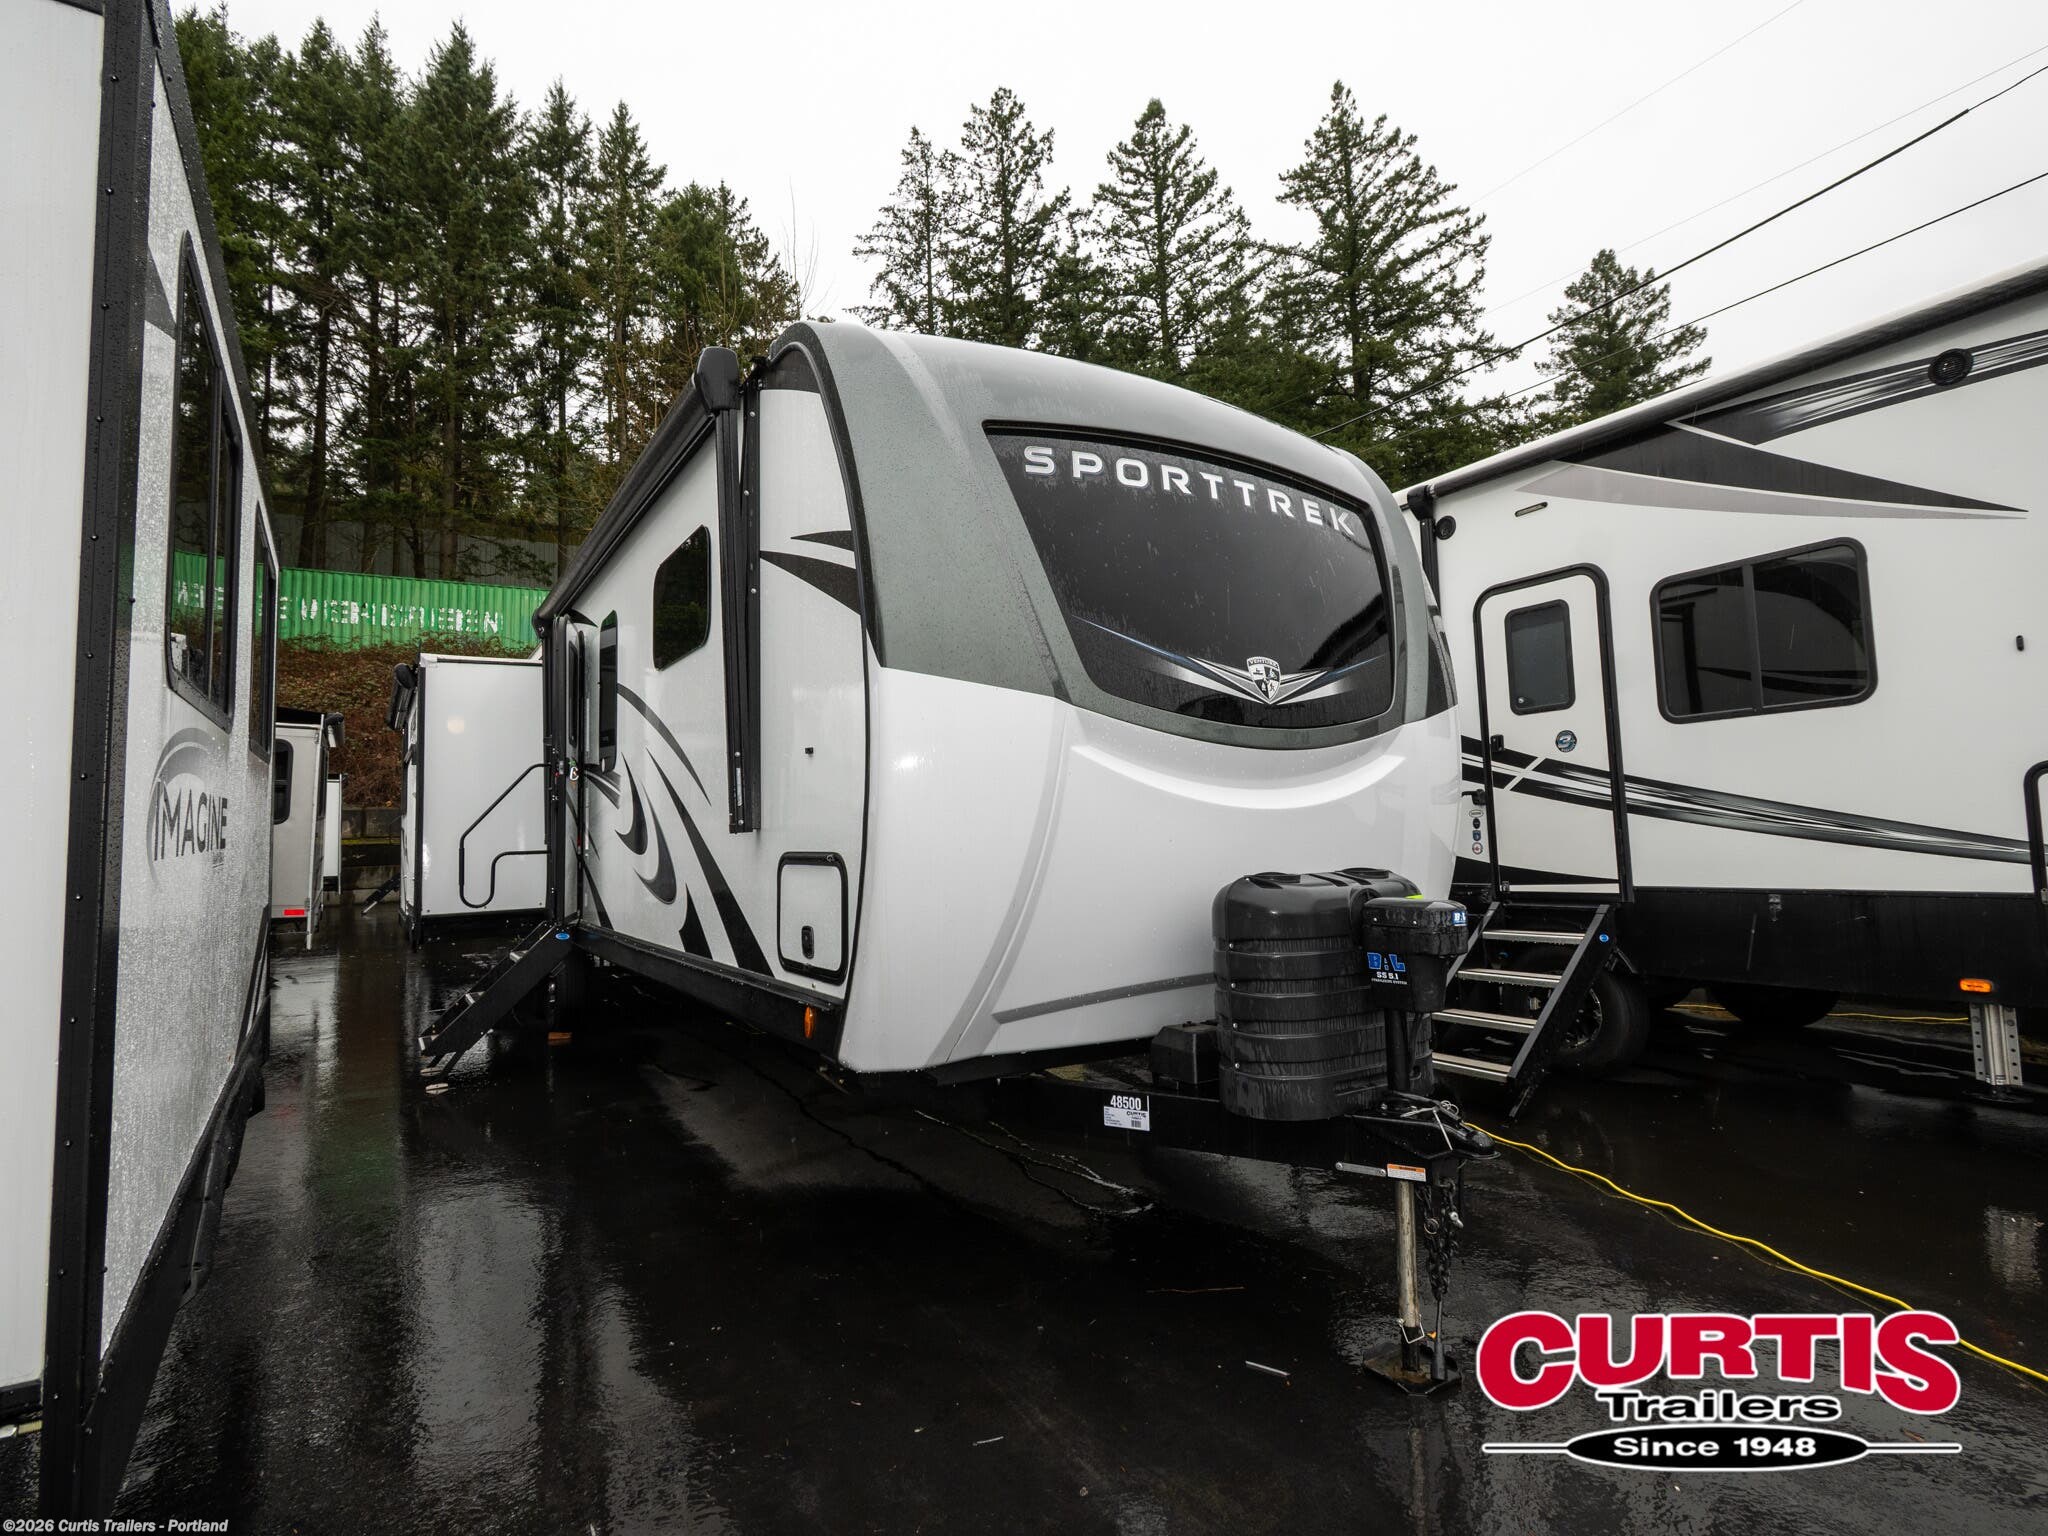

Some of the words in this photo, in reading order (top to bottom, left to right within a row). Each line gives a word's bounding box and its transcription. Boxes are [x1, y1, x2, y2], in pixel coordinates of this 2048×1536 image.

[1023, 445, 1355, 536] SPORTTREK
[153, 780, 228, 861] IMAGINE
[1110, 1094, 1142, 1111] 48500
